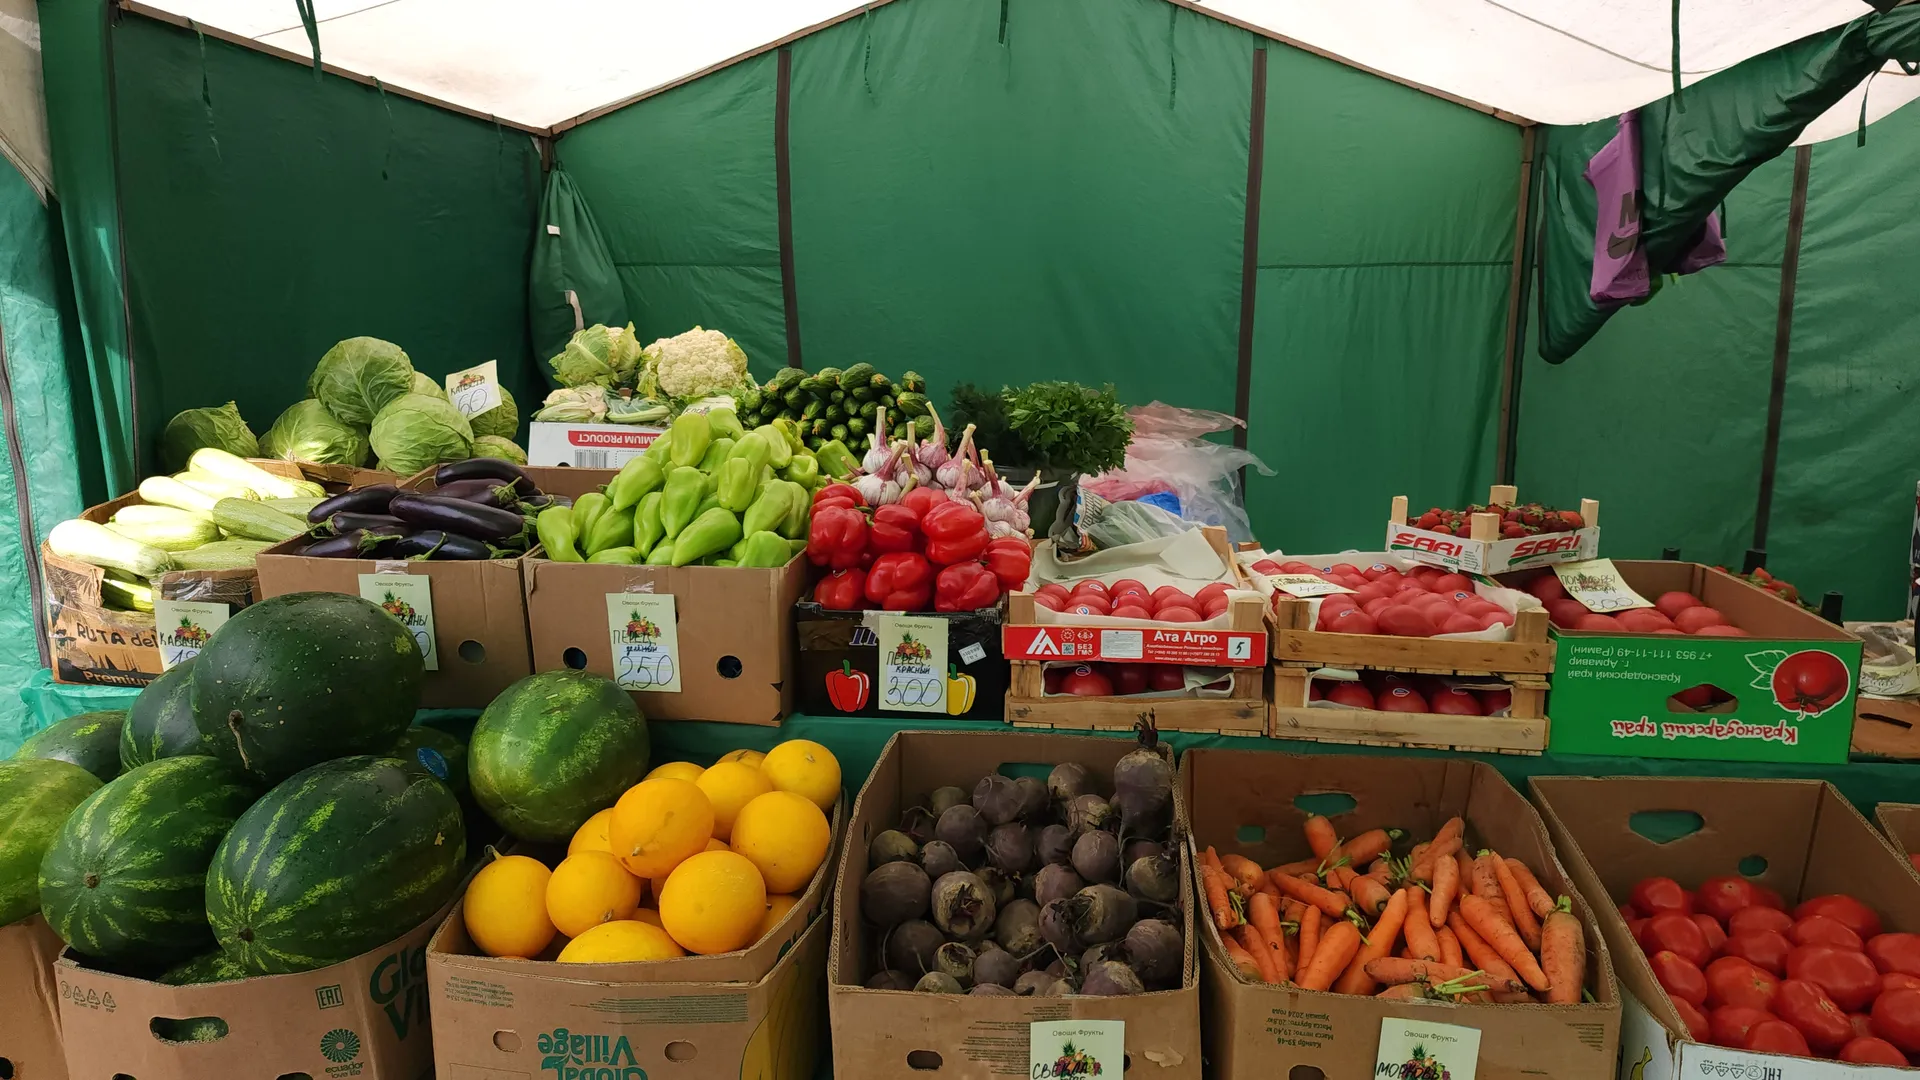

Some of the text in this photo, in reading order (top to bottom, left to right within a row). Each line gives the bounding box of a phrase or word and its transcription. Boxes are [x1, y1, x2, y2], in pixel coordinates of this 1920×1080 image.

[458, 388, 487, 418] 60
[578, 433, 656, 445] MIUM PRODUCT
[1392, 532, 1463, 557] SARI
[1511, 534, 1582, 558] SARI
[1586, 597, 1634, 610] 200
[76, 622, 159, 649] RUTA del
[1153, 630, 1218, 645] Ата Агро
[1235, 641, 1245, 655] 5
[1570, 644, 1713, 660] +7 953 111-11-49 (Рамин)
[886, 651, 926, 667] ПЕРЕЦ
[1568, 658, 1618, 669] Армавир
[617, 655, 674, 689] 250
[895, 664, 931, 675] КРАСНЫЙ
[1567, 669, 1682, 683] Краснодарский край
[884, 676, 943, 708] 300
[1611, 716, 1798, 744] Краснодарский край
[1288, 1010, 1304, 1019] 2024
[1305, 1012, 1330, 1022] Урожай
[1052, 1029, 1104, 1037] Овощи Фрукты
[1313, 1022, 1332, 1031] Масса
[1315, 1033, 1334, 1041] Масса
[1403, 1030, 1458, 1043] Овощи Фрукты
[537, 1027, 639, 1066] Village
[325, 1061, 364, 1074] ecuador
[1032, 1060, 1088, 1080] СВЕКЛА
[1376, 1061, 1440, 1080] МОРКОВЬ
